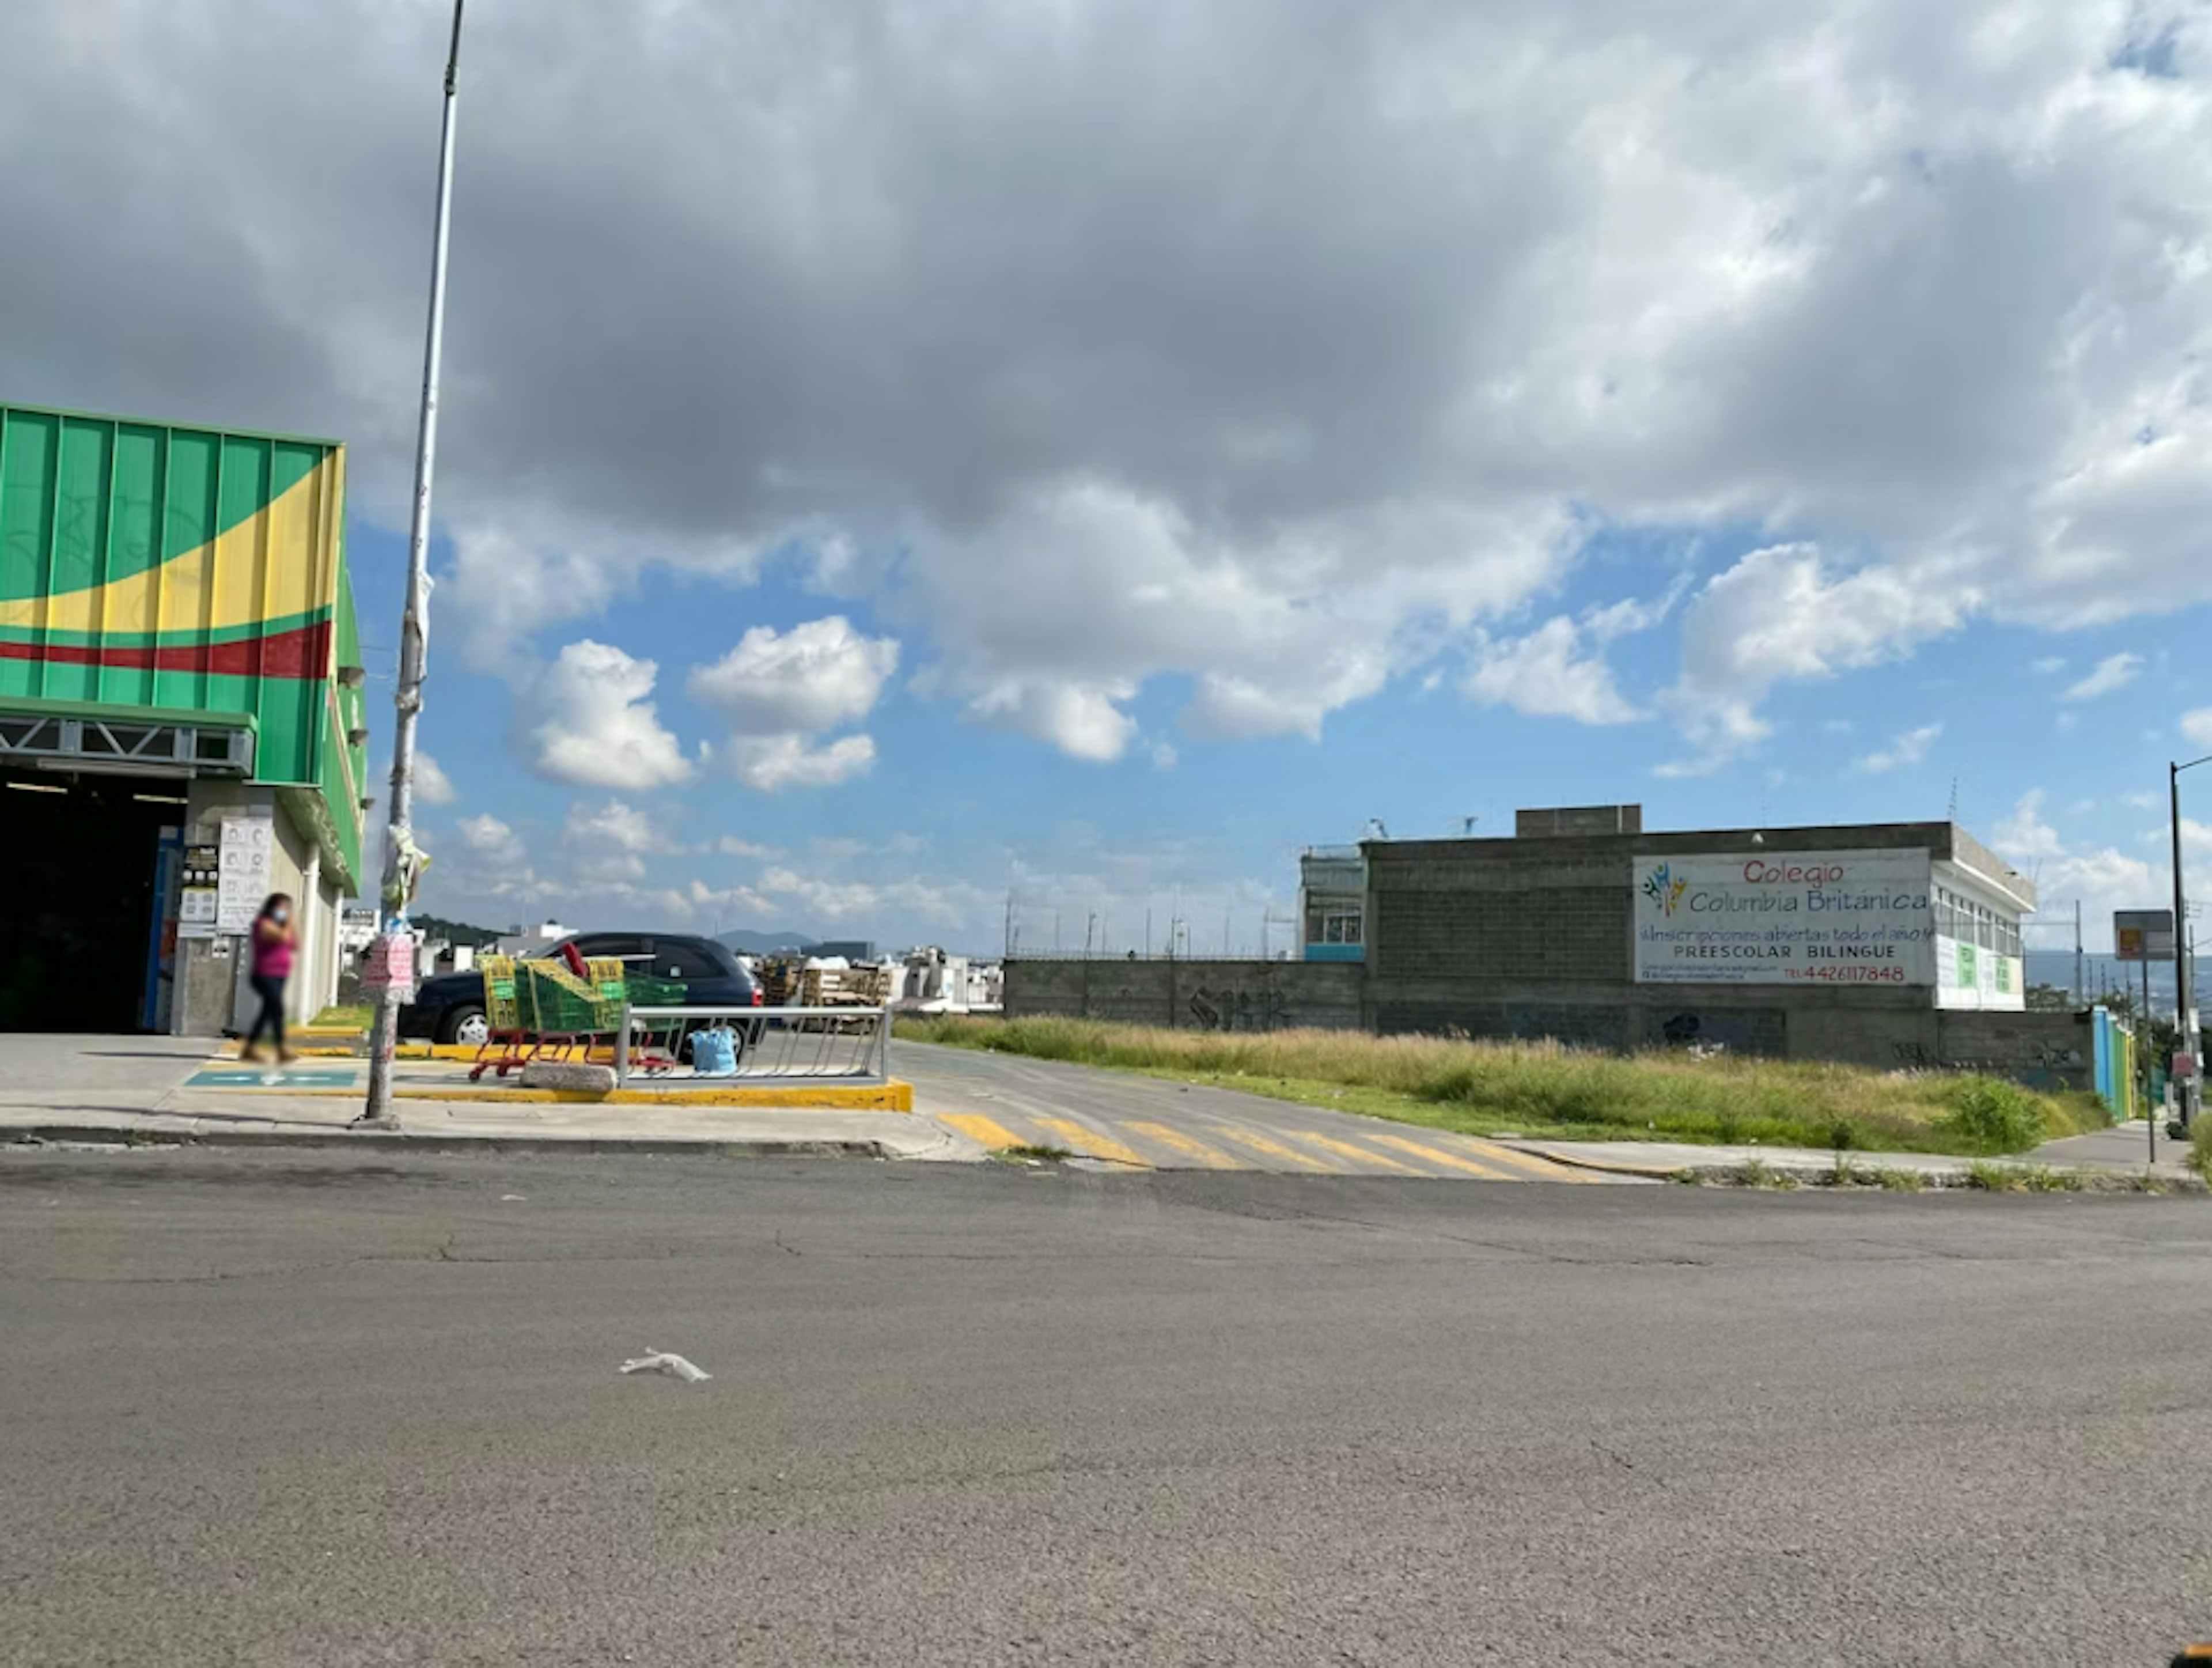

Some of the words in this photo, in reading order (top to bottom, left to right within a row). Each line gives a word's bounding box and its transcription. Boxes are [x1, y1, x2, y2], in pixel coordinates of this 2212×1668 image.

[1744, 860, 1843, 888] Colegio
[1690, 891, 1798, 913] Columbia
[1764, 925, 1830, 941] abiertas
[1834, 924, 1869, 941] todo
[1872, 924, 1885, 941] el
[1674, 945, 1791, 959] PREESCOLAR
